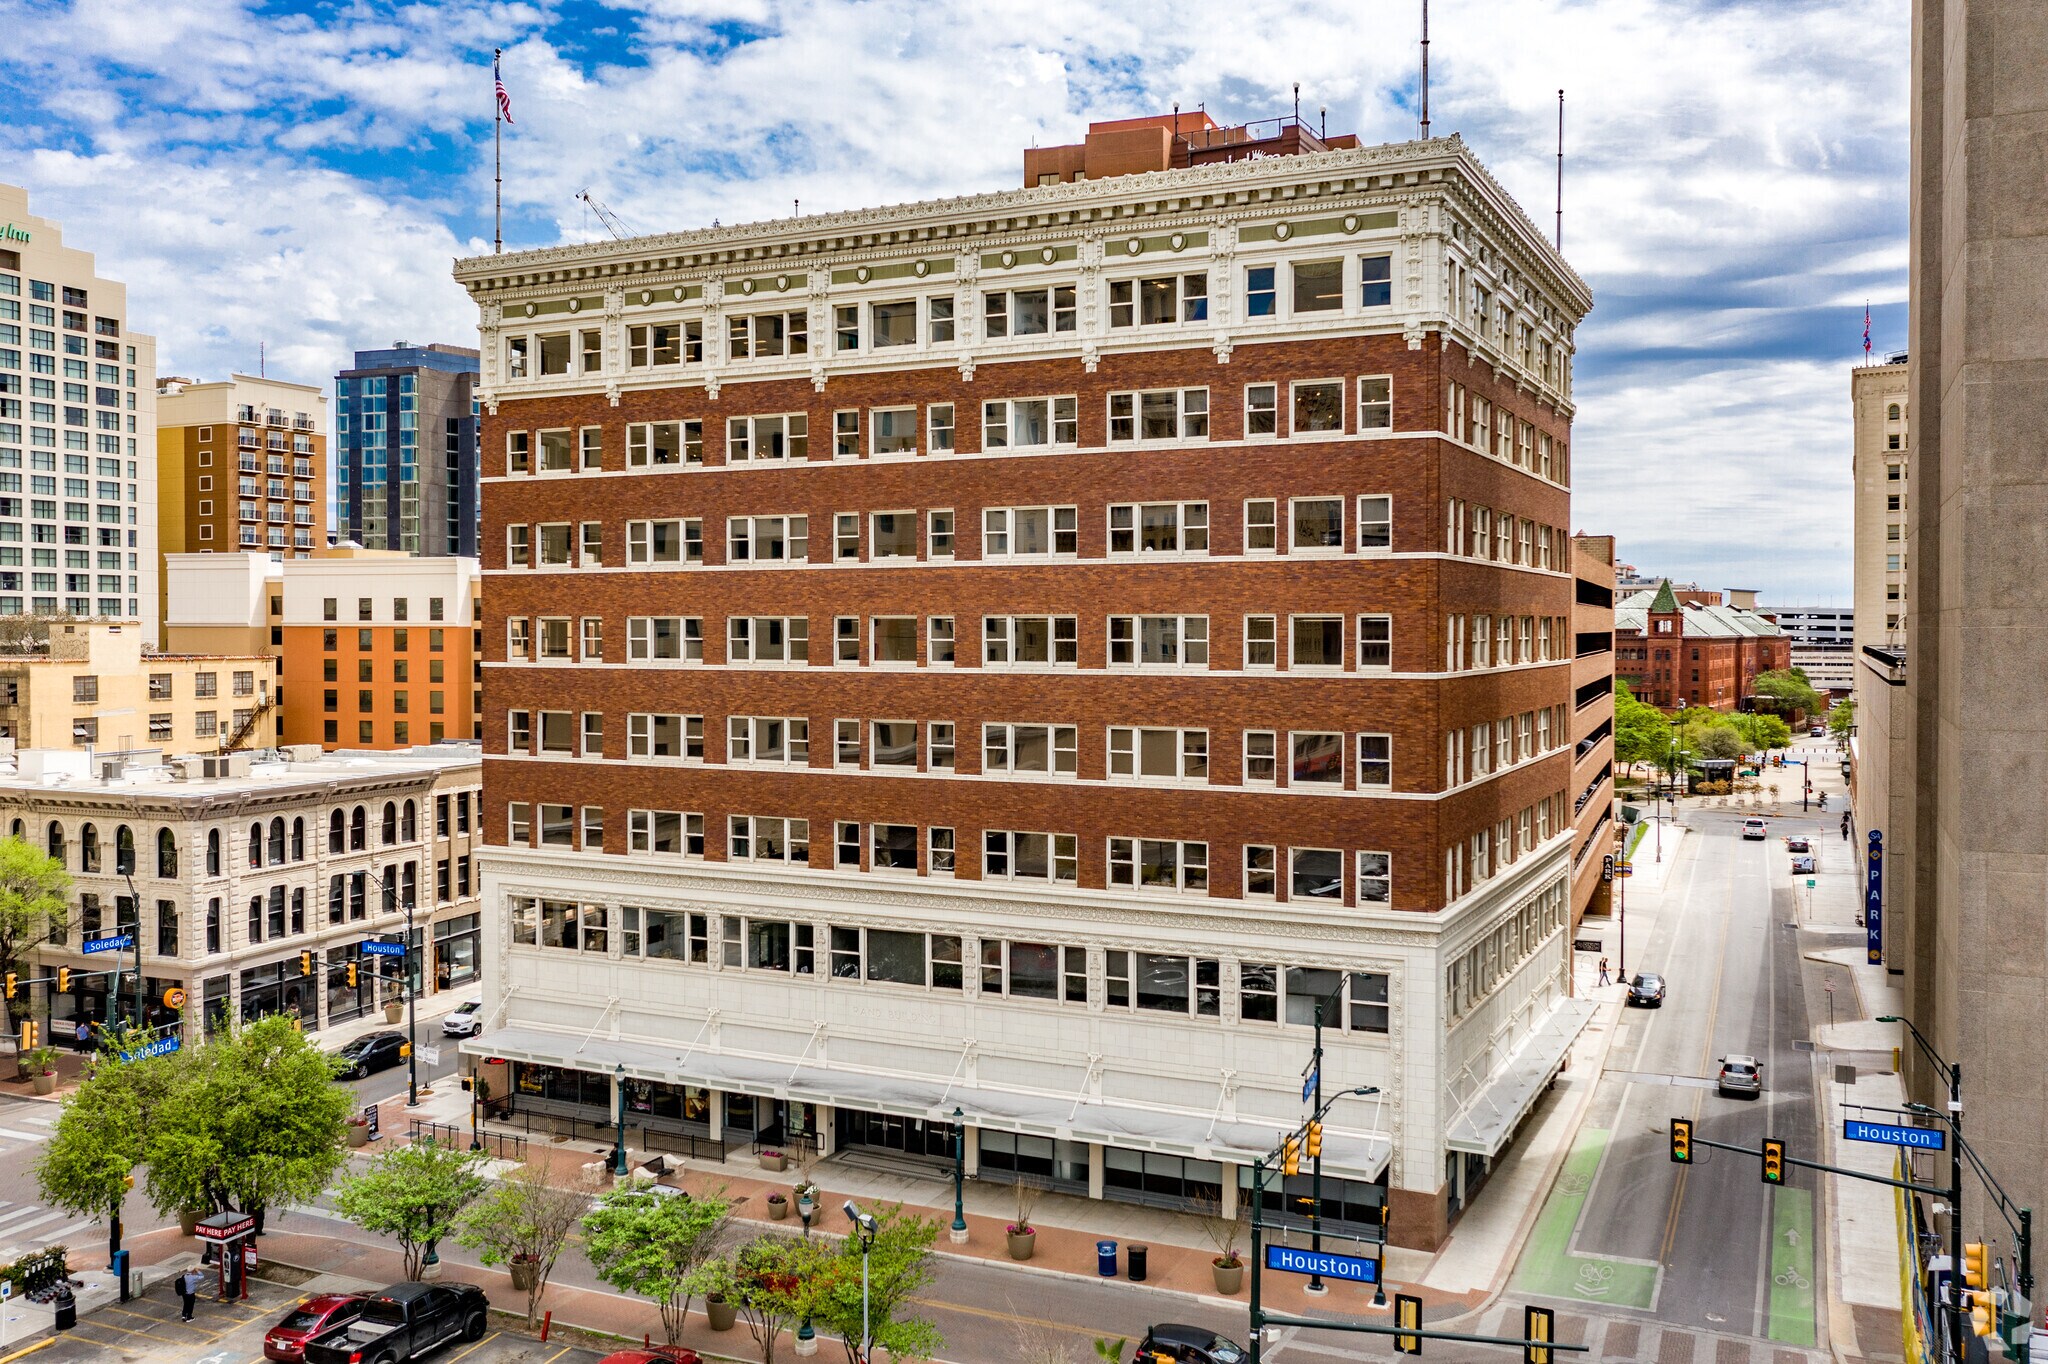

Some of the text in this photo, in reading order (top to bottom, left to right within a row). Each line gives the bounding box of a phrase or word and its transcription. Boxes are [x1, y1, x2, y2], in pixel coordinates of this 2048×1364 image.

[7, 223, 31, 243] Inn
[1870, 871, 1879, 939] PARK
[367, 944, 400, 954] Houston
[1858, 1125, 1930, 1145] Houston
[195, 1225, 222, 1237] PAY HERE
[223, 1218, 254, 1236] PAY HERE
[1282, 1252, 1360, 1276] Houston
